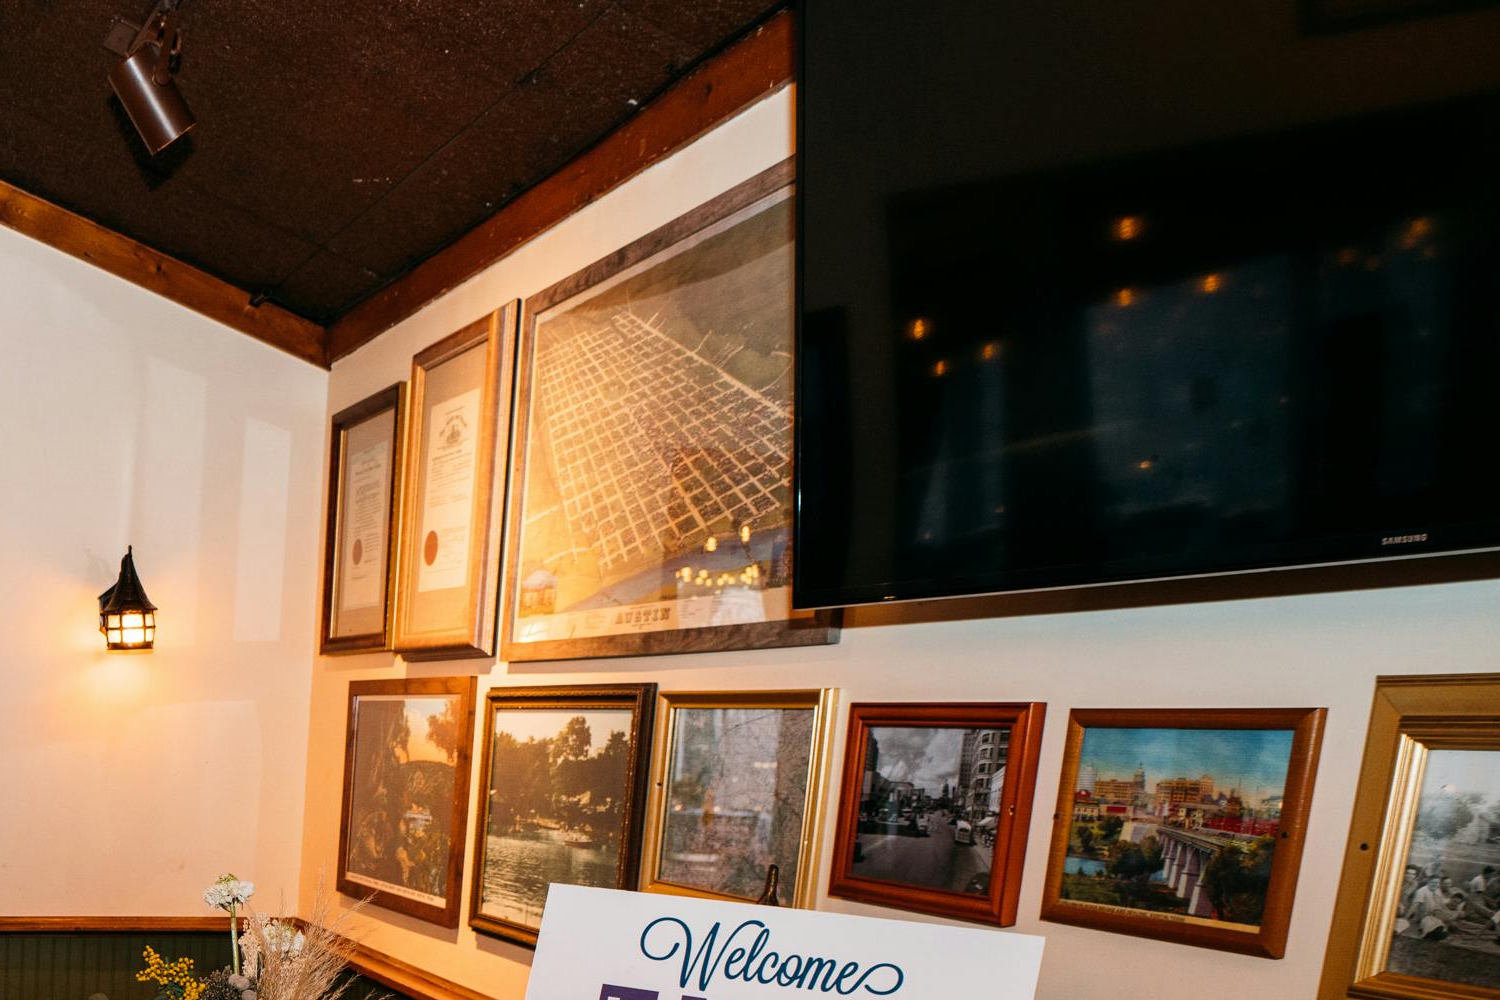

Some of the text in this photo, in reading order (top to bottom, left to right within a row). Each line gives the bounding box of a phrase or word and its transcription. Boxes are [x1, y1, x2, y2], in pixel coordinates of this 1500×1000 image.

[1381, 533, 1428, 546] SAMSUNG
[614, 607, 671, 625] AUSTIN
[640, 917, 904, 995] Welcome
